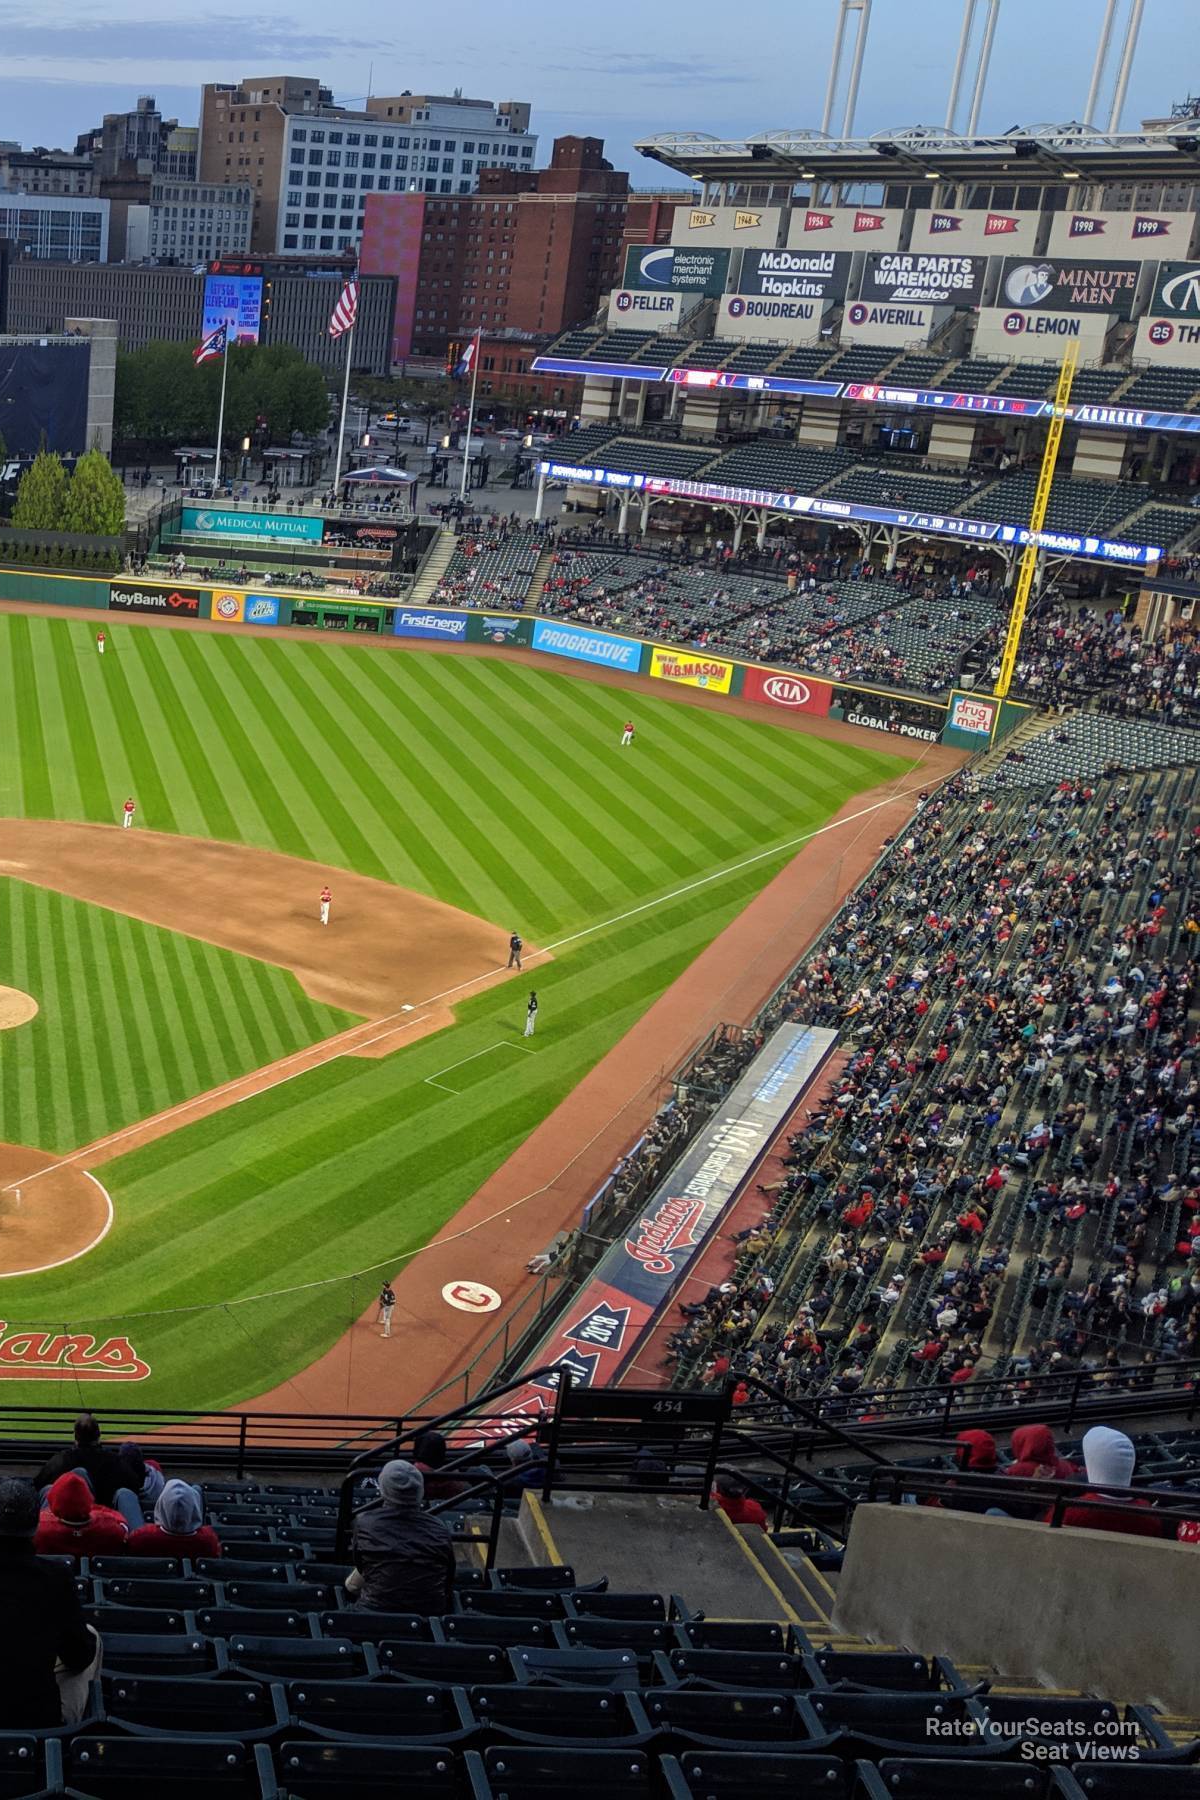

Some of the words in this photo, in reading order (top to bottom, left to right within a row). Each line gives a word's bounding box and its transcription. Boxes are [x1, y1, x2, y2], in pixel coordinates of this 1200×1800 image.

[692, 215, 707, 224] 1920
[737, 215, 752, 225] 1948
[808, 217, 824, 227] 1954
[858, 217, 875, 228] 1995
[934, 218, 951, 229] 1996
[988, 219, 1007, 230] 1997
[1074, 221, 1094, 232] 1998
[1137, 222, 1158, 233] 1999
[674, 255, 715, 266] electronic
[758, 252, 836, 272] McDonald
[880, 255, 913, 271] CAR
[917, 257, 972, 274] PARTS
[673, 265, 713, 275] merchant
[671, 275, 707, 286] systems
[761, 277, 823, 298] Hopkins
[874, 270, 975, 289] WAREHOUSE
[1057, 269, 1136, 289] MINUTE
[892, 287, 950, 300] ACDelco
[1070, 287, 1116, 305] MEN
[618, 296, 630, 307] 19
[632, 296, 674, 312] FELLER
[732, 302, 740, 313] 5
[747, 301, 814, 320] BOUDREAU
[854, 309, 862, 320] 3
[868, 309, 926, 326] AVERILL
[1007, 318, 1021, 330] 21
[1025, 316, 1081, 336] LEMON
[1152, 326, 1170, 339] 25
[216, 516, 263, 530] MEDICAL
[265, 520, 309, 533] MUTUAL
[110, 590, 167, 607] KeyBank
[401, 613, 466, 632] FirstEnergy
[538, 628, 633, 663] PROGRESSIVE
[771, 680, 802, 701] KIA
[956, 700, 987, 721] drug
[847, 712, 890, 732] GLOBAL
[900, 724, 937, 742] POKER
[956, 717, 990, 732] mart
[709, 1117, 763, 1154] 1901
[687, 1151, 732, 1197] ESTABLISHED
[625, 1197, 705, 1275] Indians
[581, 1315, 619, 1343] 2018
[653, 1401, 683, 1412] 454
